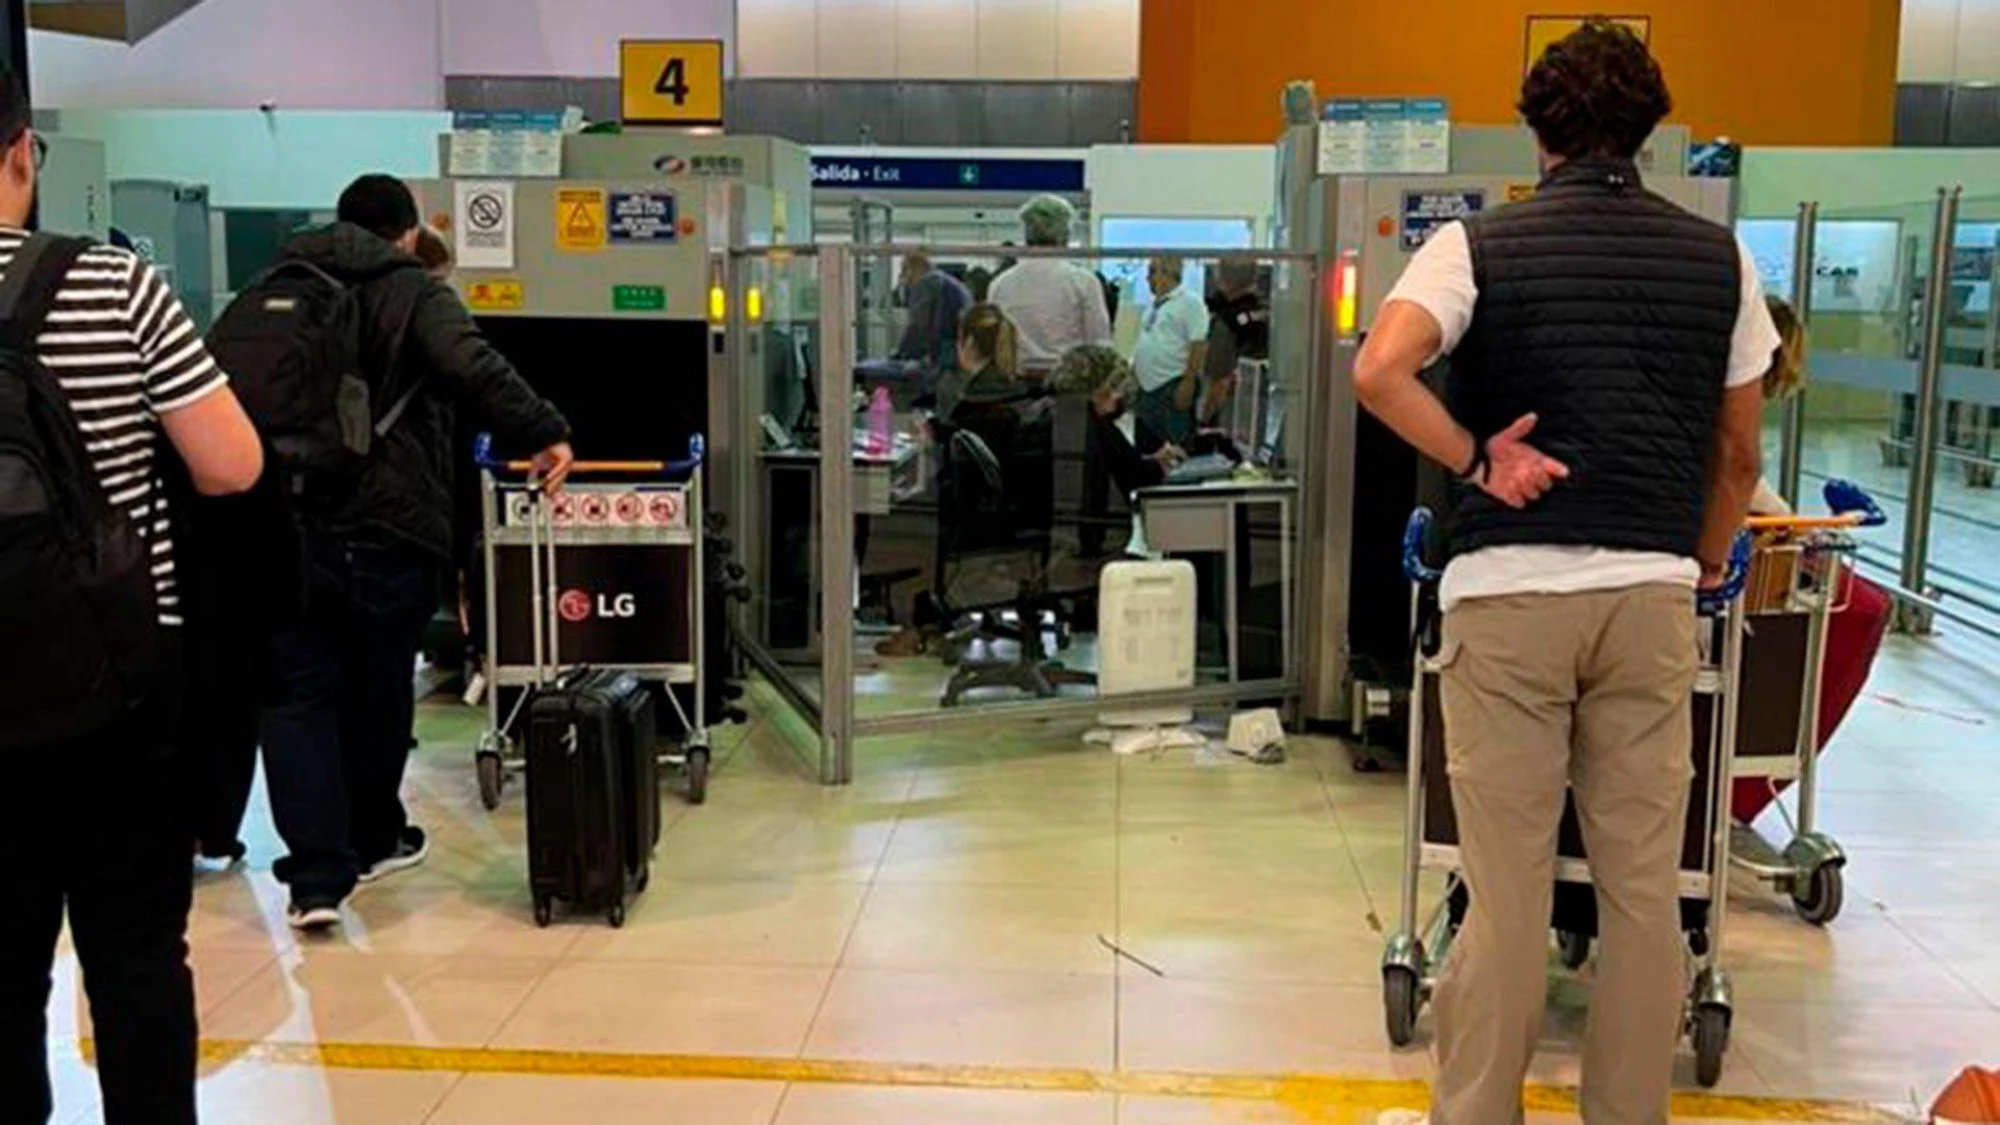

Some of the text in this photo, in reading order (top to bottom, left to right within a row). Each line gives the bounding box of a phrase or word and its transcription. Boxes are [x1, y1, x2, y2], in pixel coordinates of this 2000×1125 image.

[655, 58, 690, 106] 4
[809, 164, 900, 181] Salida Exit
[597, 593, 636, 618] LG
